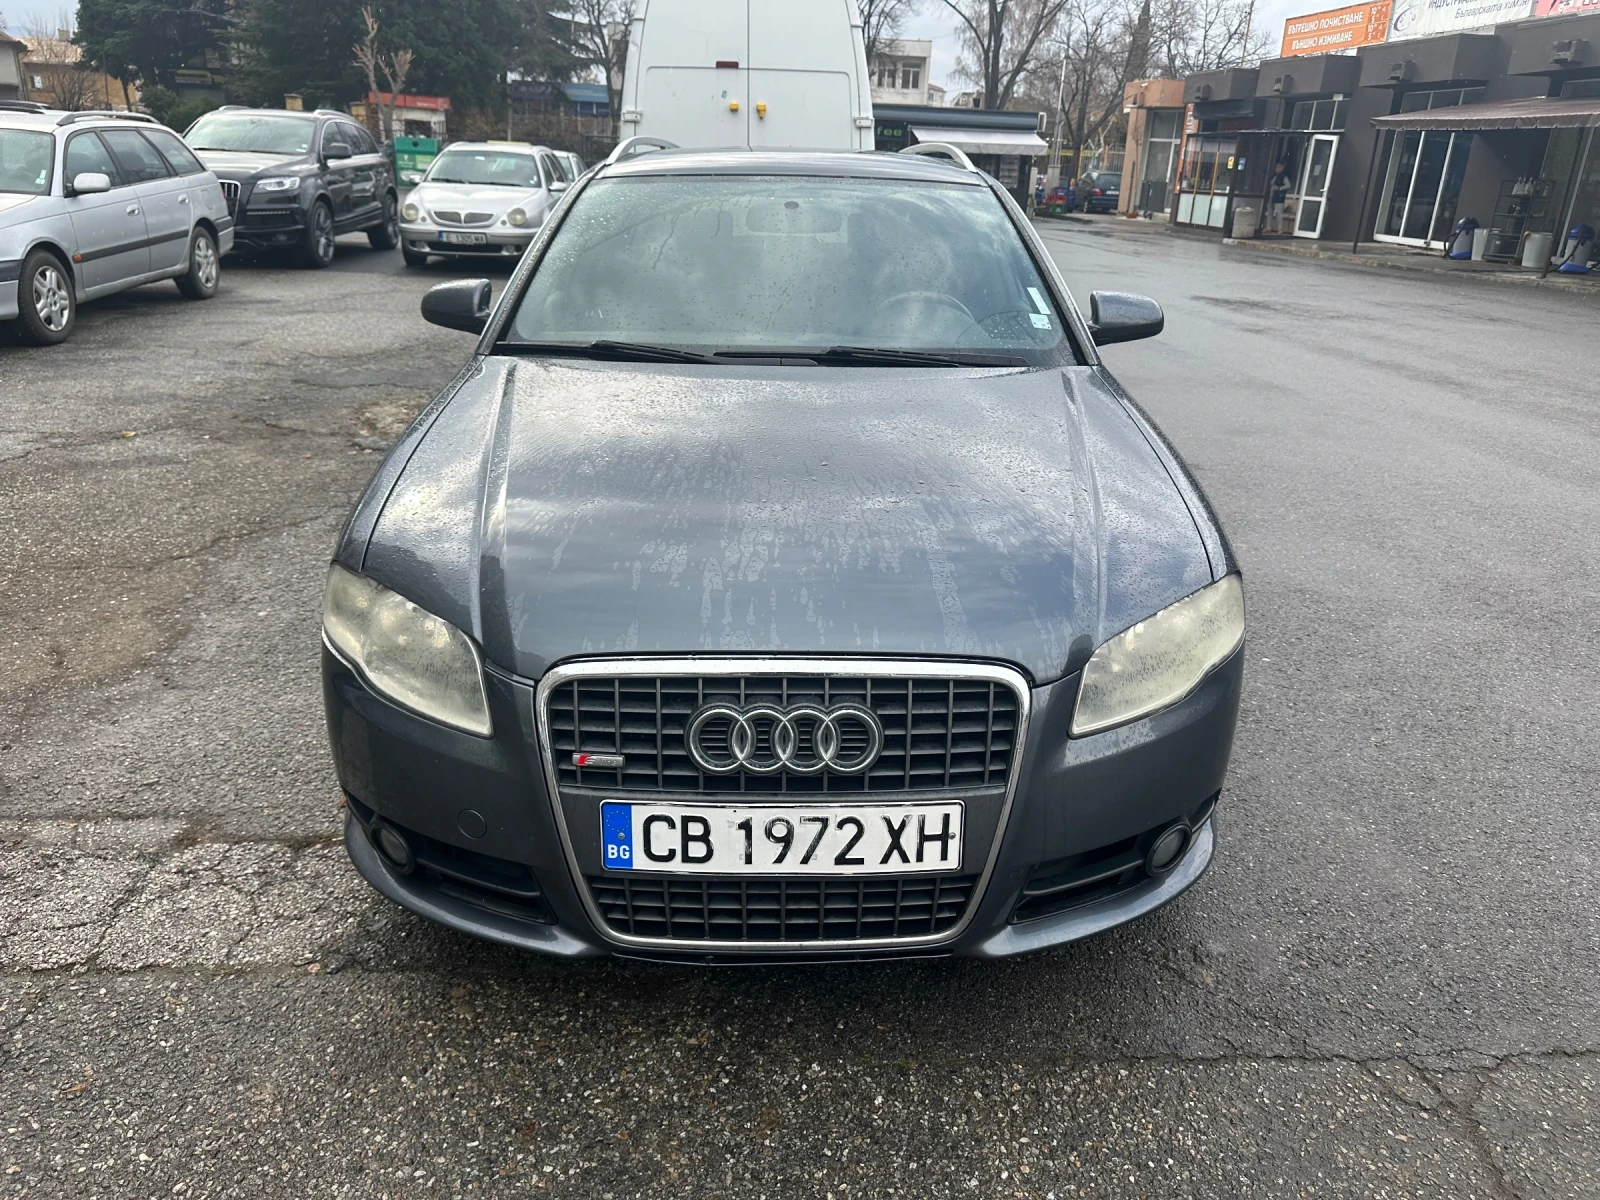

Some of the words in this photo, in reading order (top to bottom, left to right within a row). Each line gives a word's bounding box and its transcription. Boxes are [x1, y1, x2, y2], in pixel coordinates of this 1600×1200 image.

[1288, 21, 1318, 35] ВЪТРЕШНО
[1320, 11, 1363, 29] ПОЧИСТВАНЕ
[1292, 37, 1318, 50] ВЪНШНО
[1318, 31, 1353, 46] ИЗМИВАНЕ
[643, 814, 714, 863] CB
[736, 815, 865, 865] 1972
[879, 813, 950, 864] XH
[608, 844, 630, 859] BG
